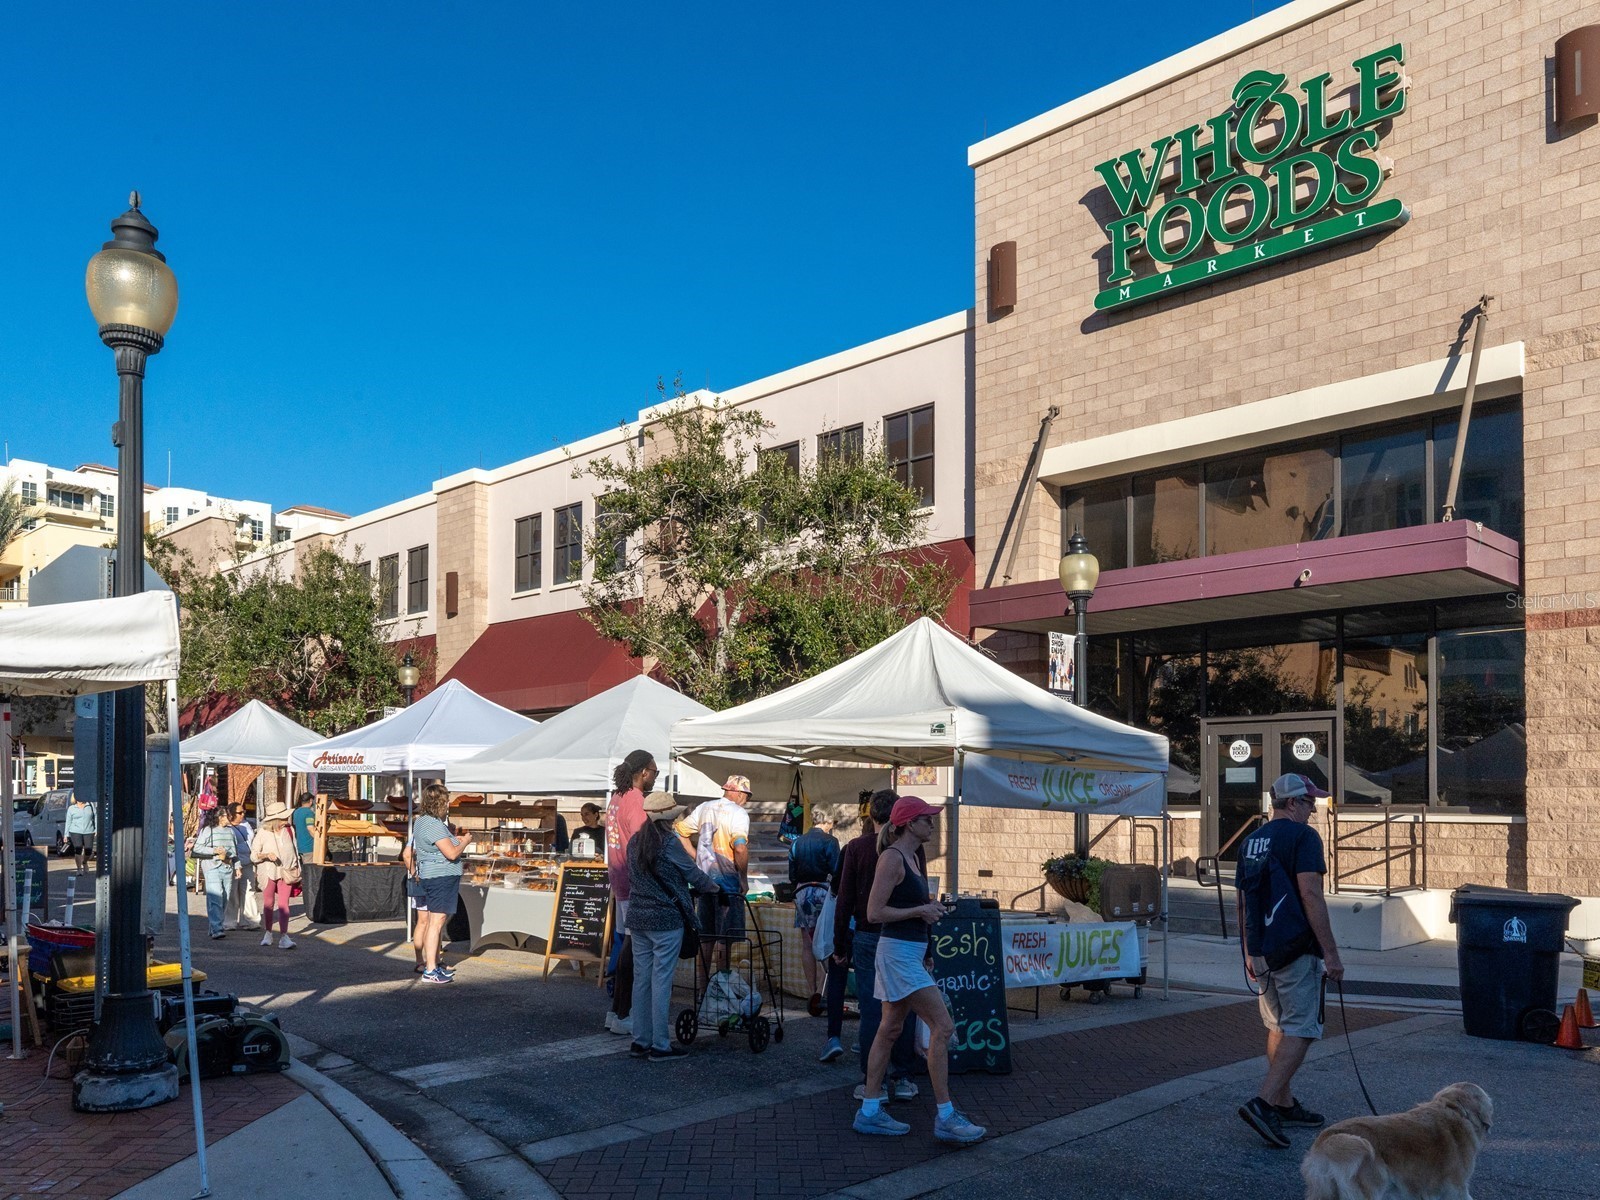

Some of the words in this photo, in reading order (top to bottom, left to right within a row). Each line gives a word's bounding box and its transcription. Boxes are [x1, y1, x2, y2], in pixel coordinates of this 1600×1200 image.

[1094, 43, 1406, 216] WHOLE
[1106, 130, 1384, 283] FOODS
[1119, 211, 1366, 300] MARKET
[313, 751, 364, 768] Artizonia
[1007, 774, 1038, 792] FRESH
[1041, 768, 1099, 807] JUICE
[1246, 837, 1271, 859] Lite
[931, 922, 995, 965] esh
[1012, 931, 1047, 950] FRESH
[1053, 929, 1125, 978] JUICES
[1006, 952, 1053, 974] ORGANIC
[936, 970, 991, 994] ganic
[954, 1018, 1006, 1051] ces
